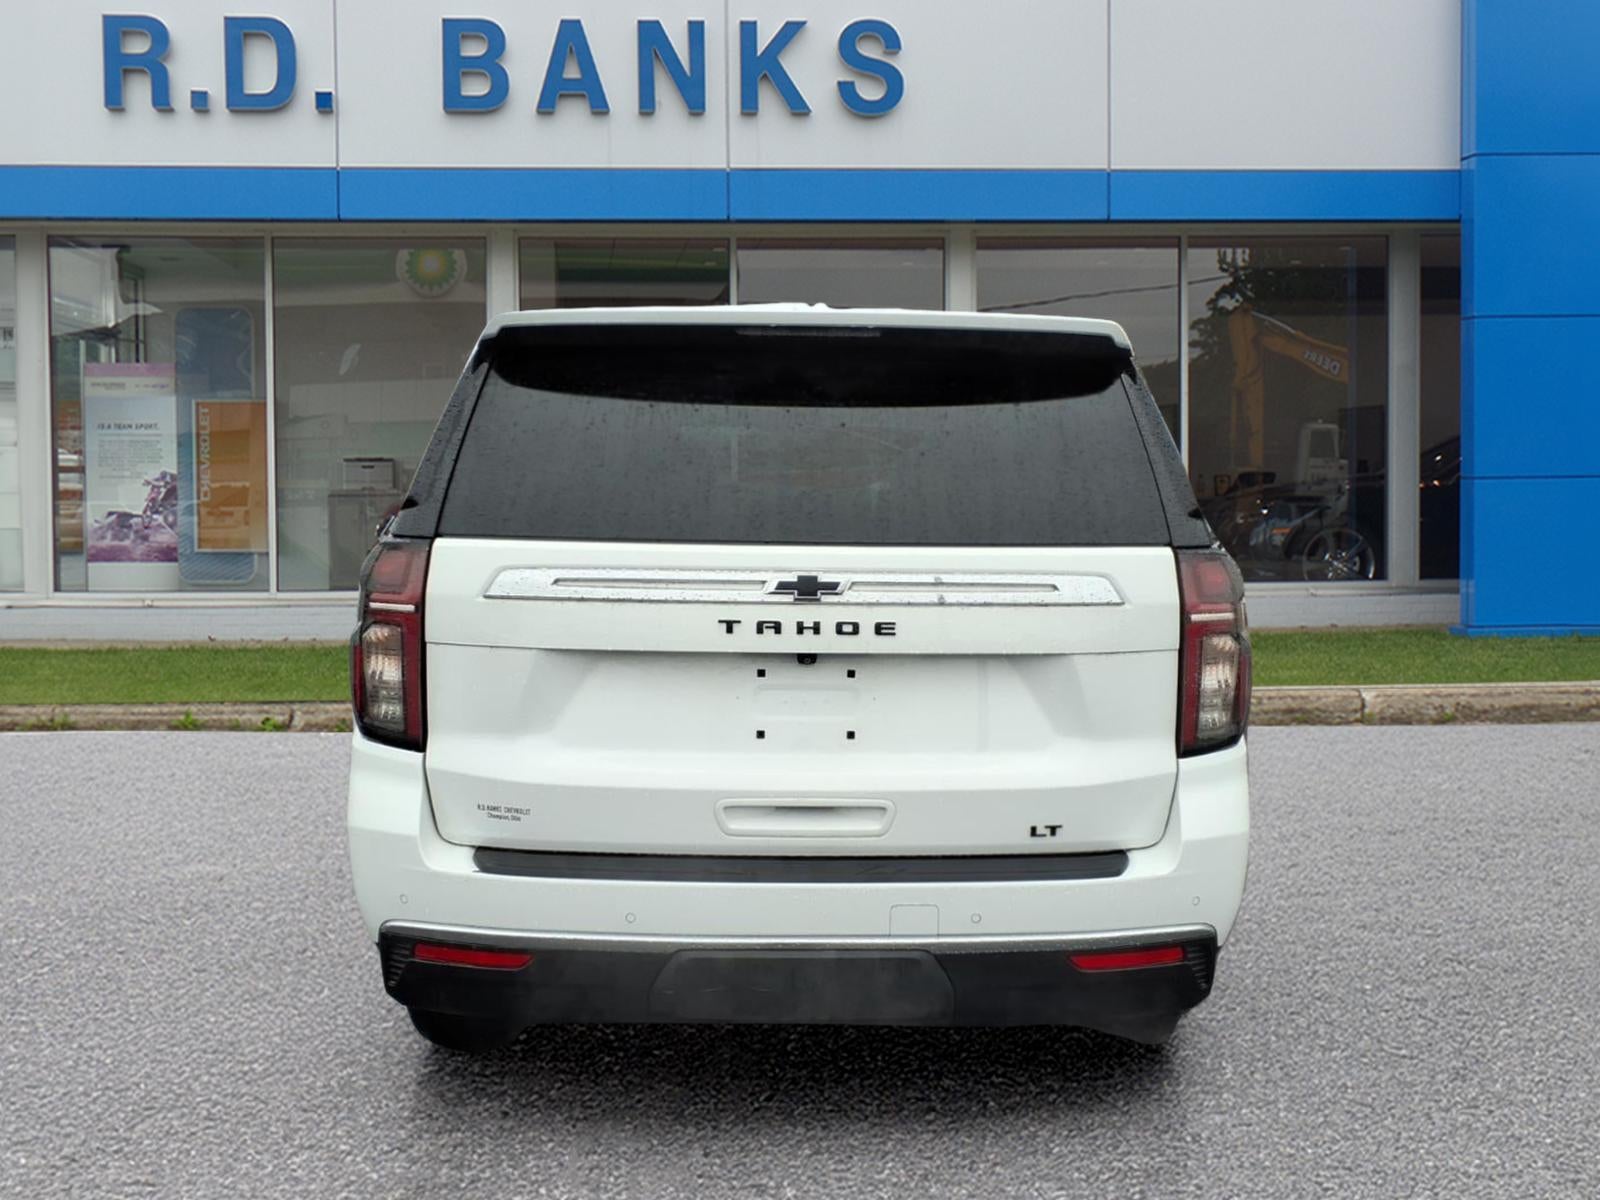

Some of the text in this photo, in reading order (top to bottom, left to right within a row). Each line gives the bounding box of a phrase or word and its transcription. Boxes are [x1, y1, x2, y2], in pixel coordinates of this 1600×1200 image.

[101, 13, 905, 117] R.D. BANKS
[199, 406, 211, 501] CHEVROLET
[718, 619, 897, 636] TAHOE
[503, 806, 531, 816] CHEVROLET
[1030, 825, 1063, 837] LT
